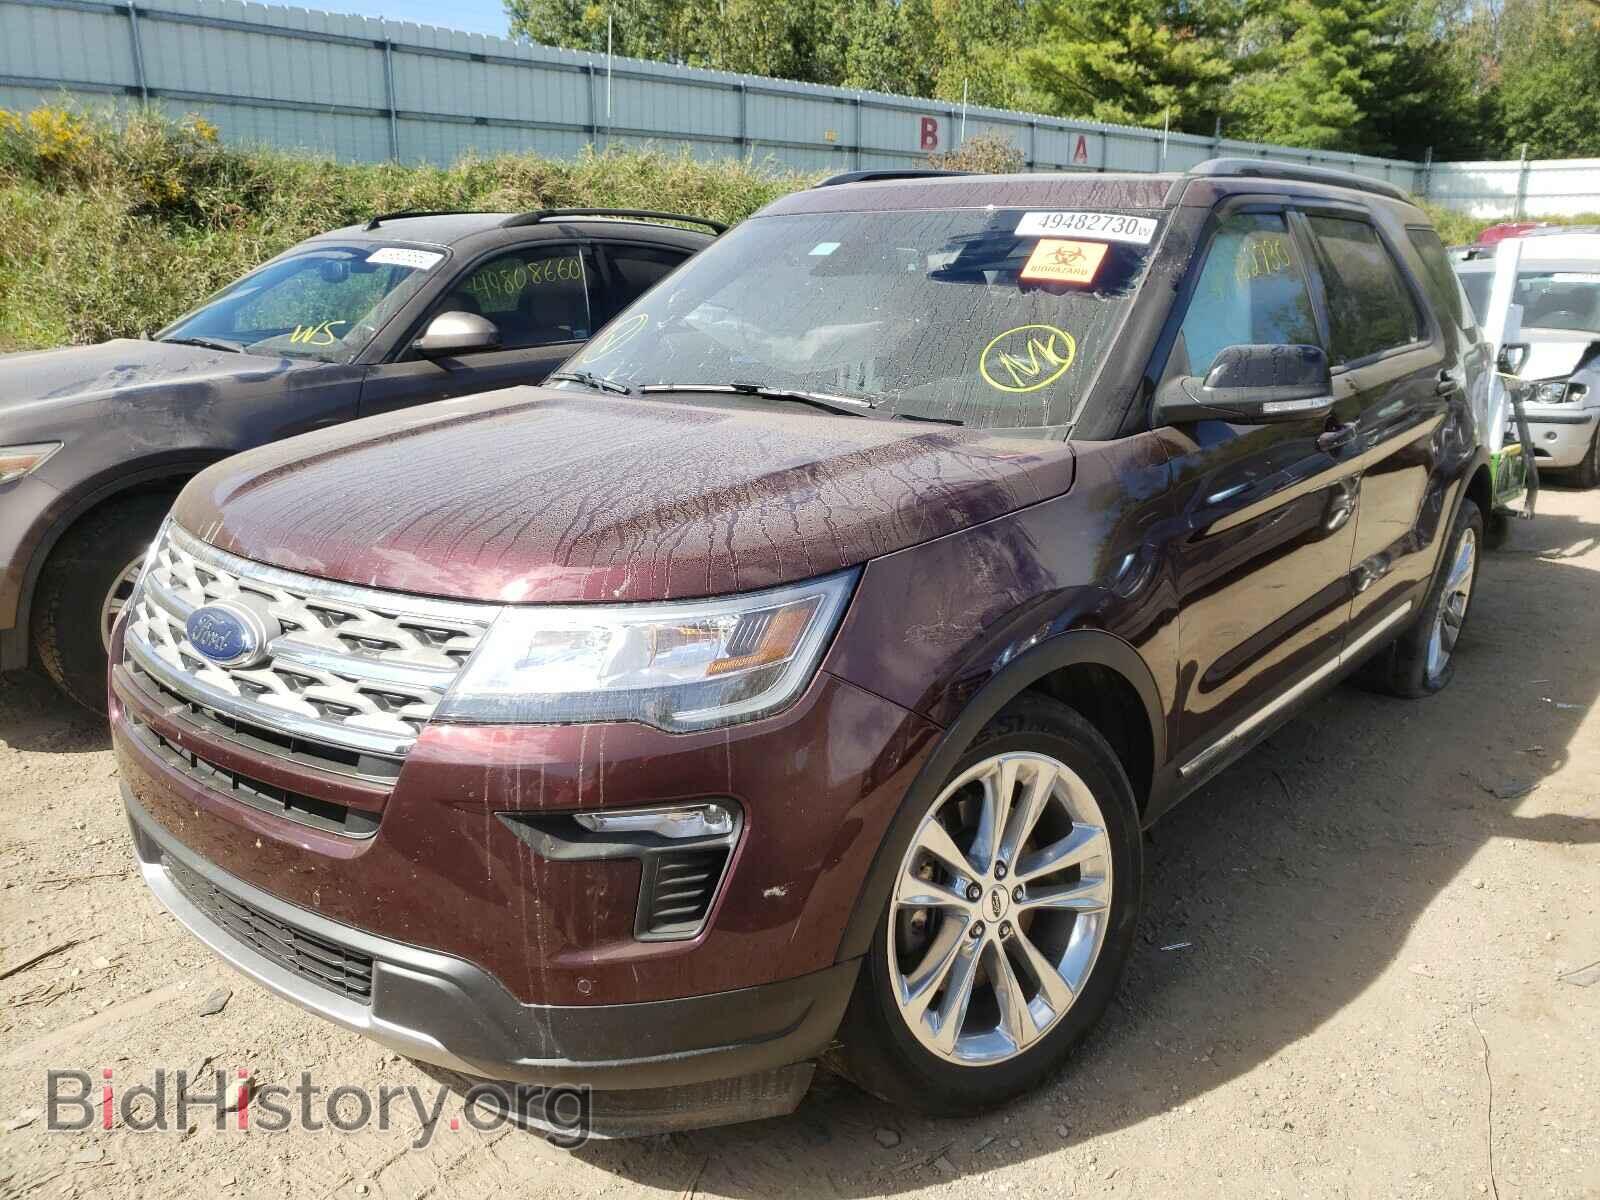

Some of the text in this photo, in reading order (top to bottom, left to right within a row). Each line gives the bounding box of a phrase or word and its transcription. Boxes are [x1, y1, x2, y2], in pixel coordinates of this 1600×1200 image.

[921, 117, 938, 149] B
[1073, 135, 1088, 164] A
[1029, 265, 1089, 276] BIOHAZARD
[290, 319, 347, 346] WS
[191, 613, 233, 652] Ford
